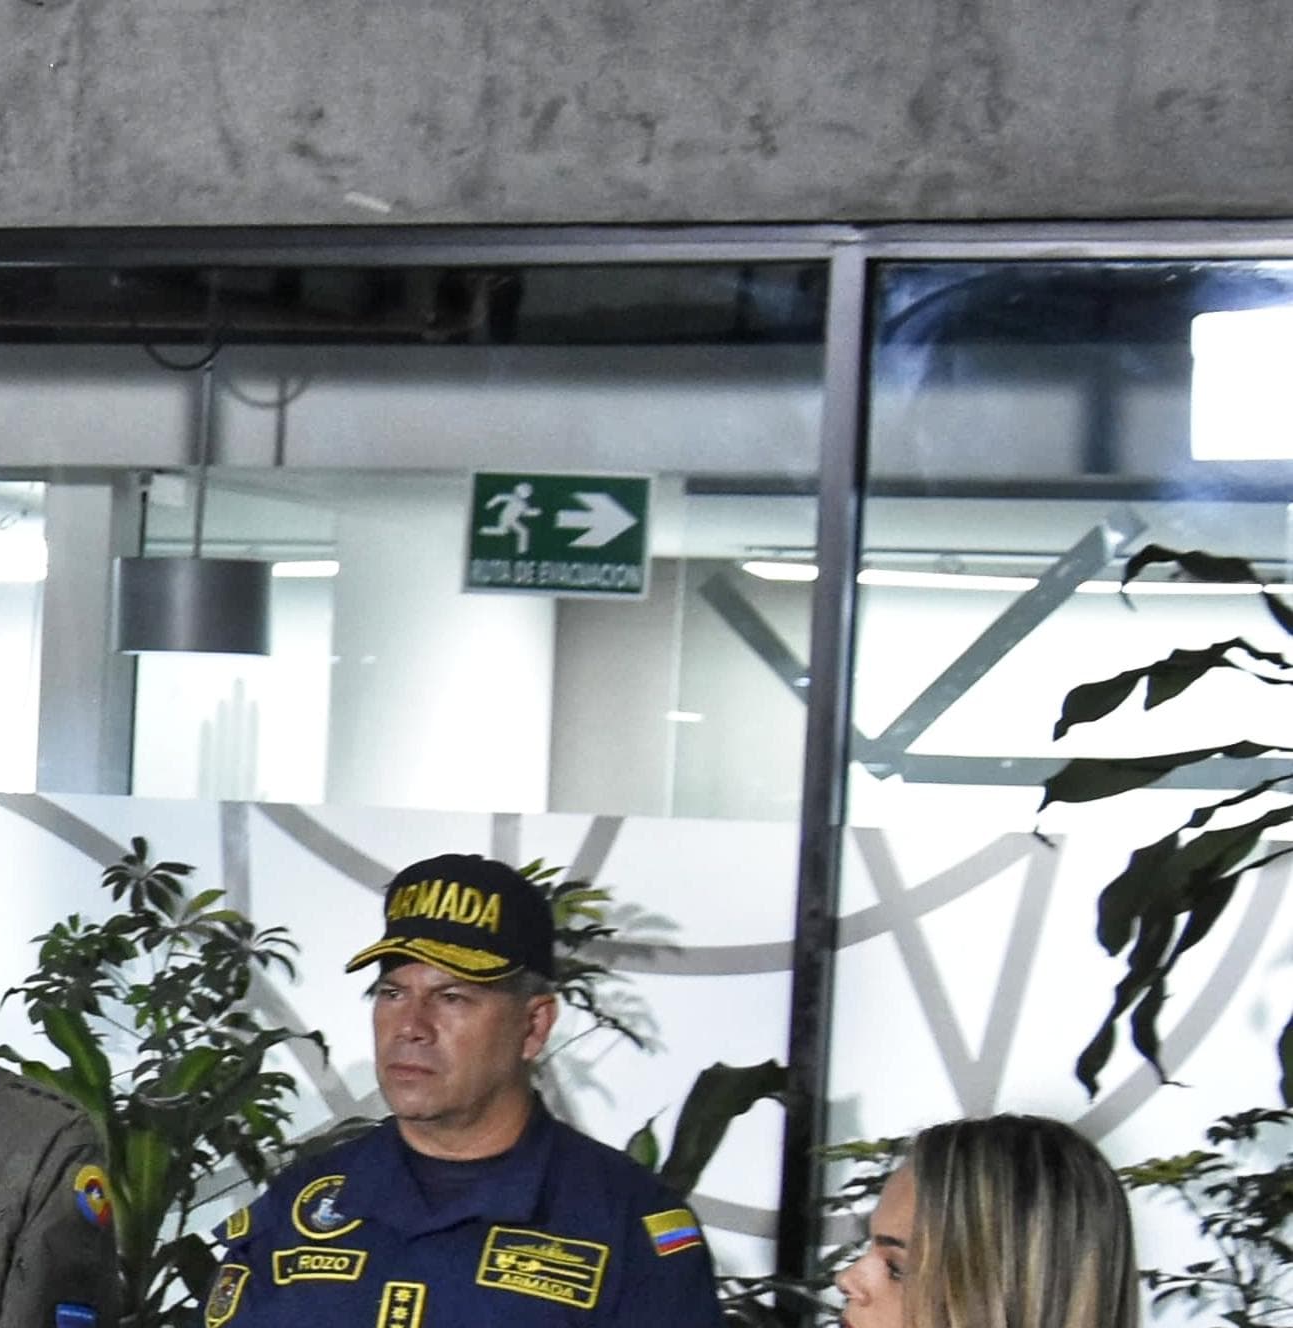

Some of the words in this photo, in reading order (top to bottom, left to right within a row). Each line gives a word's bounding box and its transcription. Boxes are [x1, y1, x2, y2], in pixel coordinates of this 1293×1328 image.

[389, 879, 502, 932] ARMADA
[298, 1254, 350, 1271] ROZO
[499, 1273, 575, 1298] ARMADA
